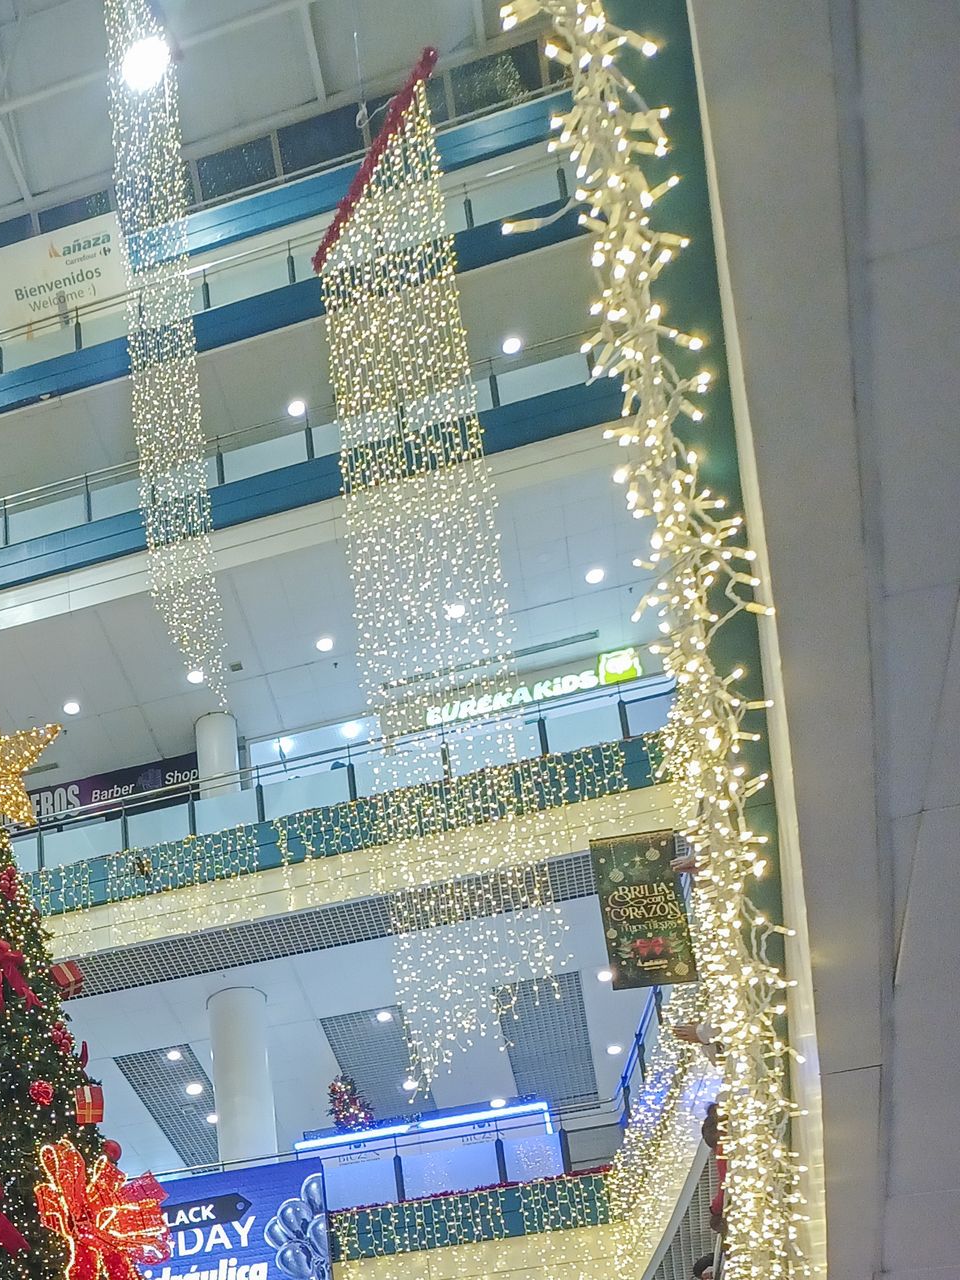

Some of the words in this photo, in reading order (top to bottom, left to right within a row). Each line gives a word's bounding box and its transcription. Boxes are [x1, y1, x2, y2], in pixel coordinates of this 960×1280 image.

[62, 232, 111, 257] añaza
[65, 252, 98, 266] Carrefour
[14, 267, 102, 301] Bienvenidos
[29, 288, 85, 313] Welcome
[91, 783, 136, 803] Barber
[164, 768, 198, 785] Shop
[610, 901, 681, 922] CORAZÓN
[170, 1215, 257, 1257] DAY
